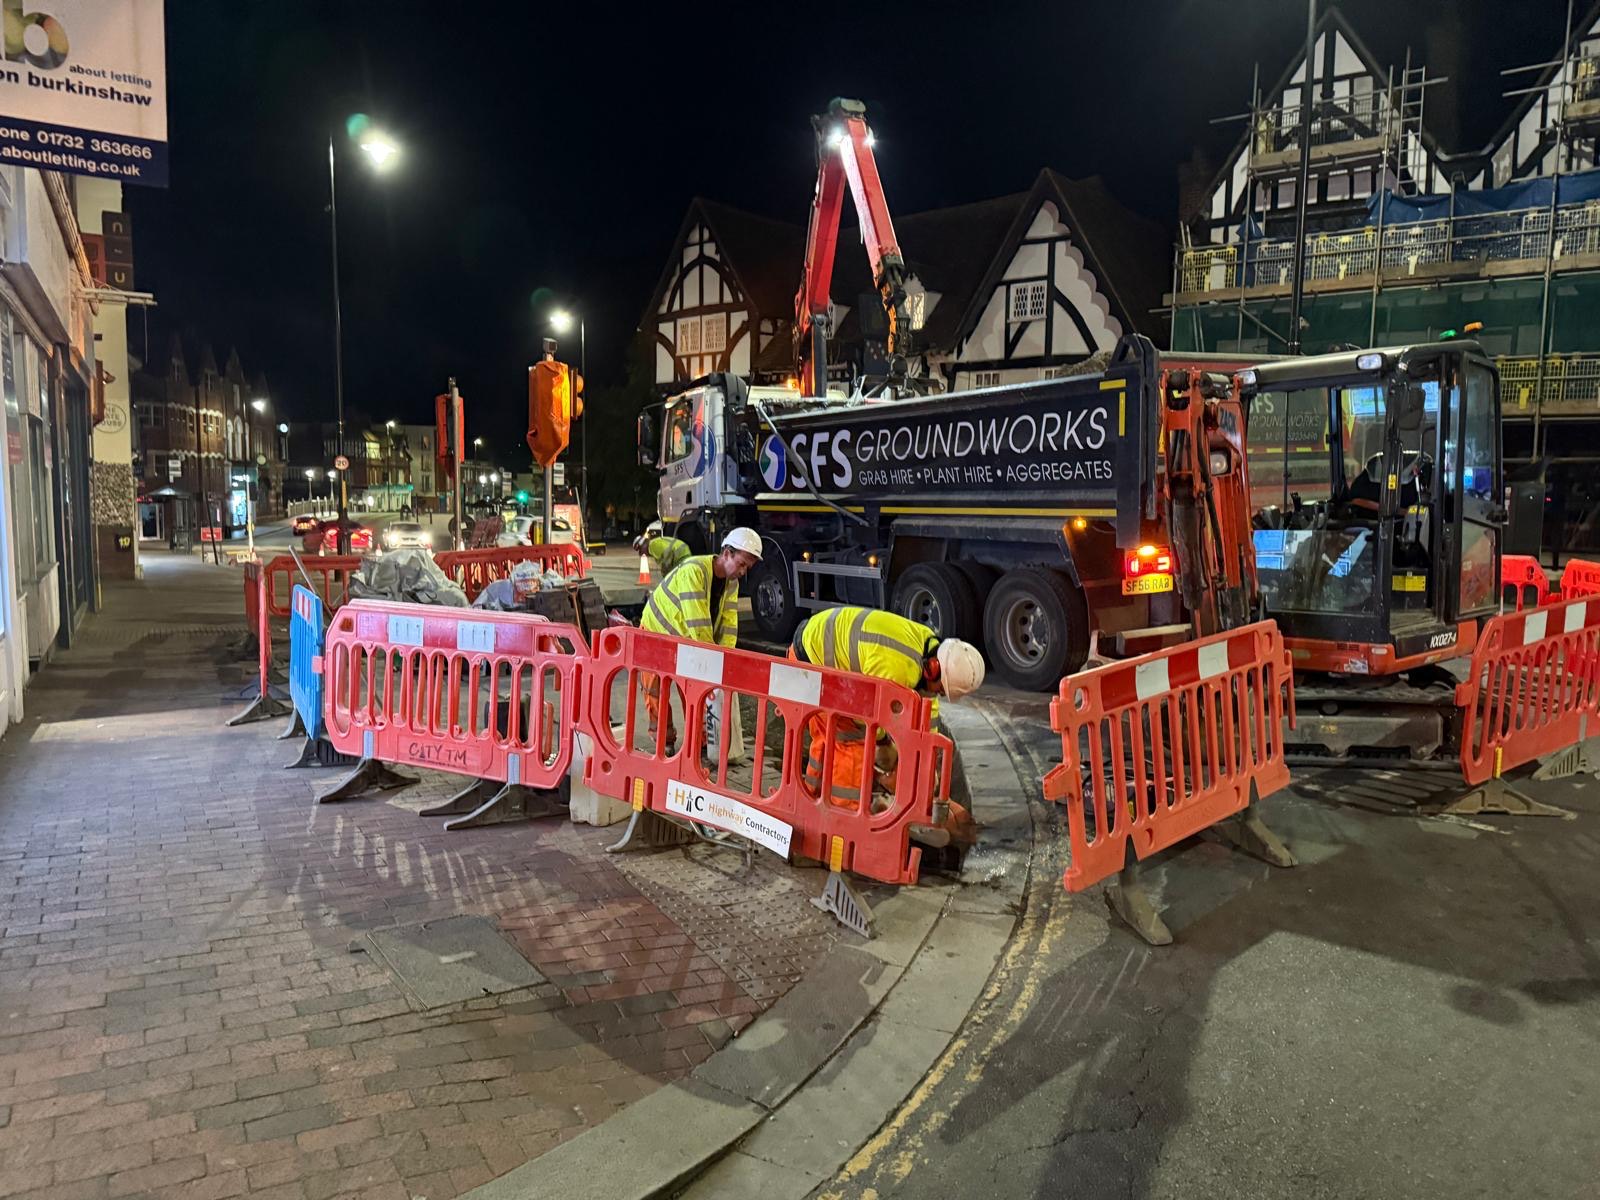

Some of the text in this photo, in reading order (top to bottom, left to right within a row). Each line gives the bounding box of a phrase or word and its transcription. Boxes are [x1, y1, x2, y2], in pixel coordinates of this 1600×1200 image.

[28, 71, 152, 106] burkinshaw
[69, 64, 152, 89] about letting
[37, 130, 85, 149] 01732
[90, 138, 152, 160] 363666
[790, 407, 1107, 489] SFS GROUNDWORKS
[859, 460, 1113, 486] GRAB HIRE PLANT HIRE AGGREGATES
[1126, 579, 1150, 593] SF56
[446, 749, 468, 766] TM
[708, 801, 745, 824] Highway
[745, 816, 788, 845] Contractors
